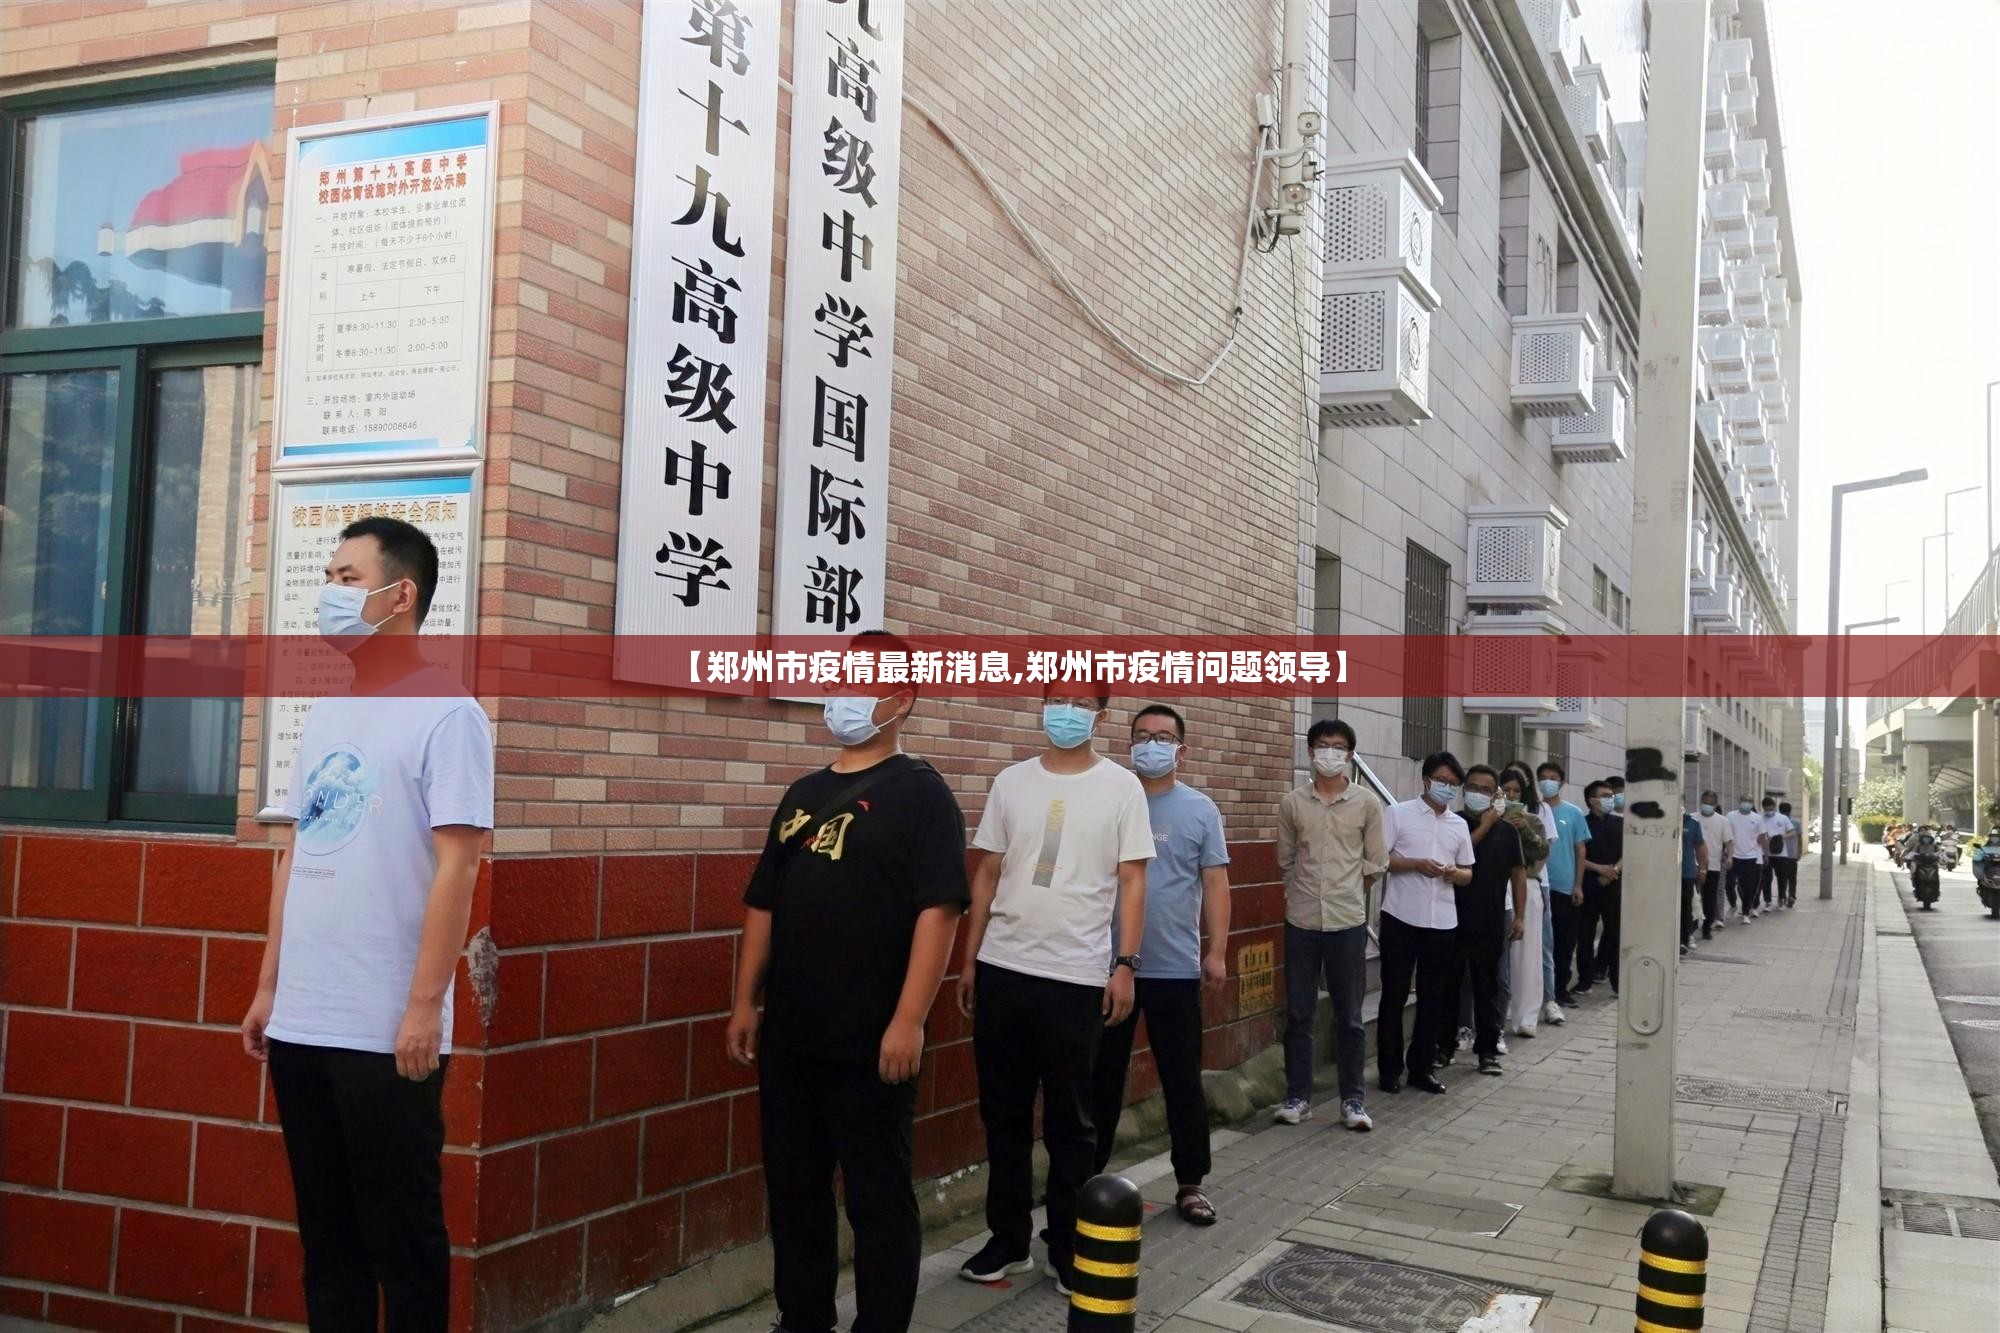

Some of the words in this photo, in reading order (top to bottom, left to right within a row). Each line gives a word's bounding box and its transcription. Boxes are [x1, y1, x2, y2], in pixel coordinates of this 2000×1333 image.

[319, 153, 467, 187] 郑州第十九高级中学
[318, 172, 467, 205] 校园体育设施对外开放公示牌
[360, 292, 376, 302] 上午
[424, 286, 440, 296] 下午
[654, 0, 753, 607] 第十九高级中学
[409, 316, 450, 327] 2:30-5:30
[407, 341, 448, 353] 2:00-5:00
[779, 808, 854, 861] 中国
